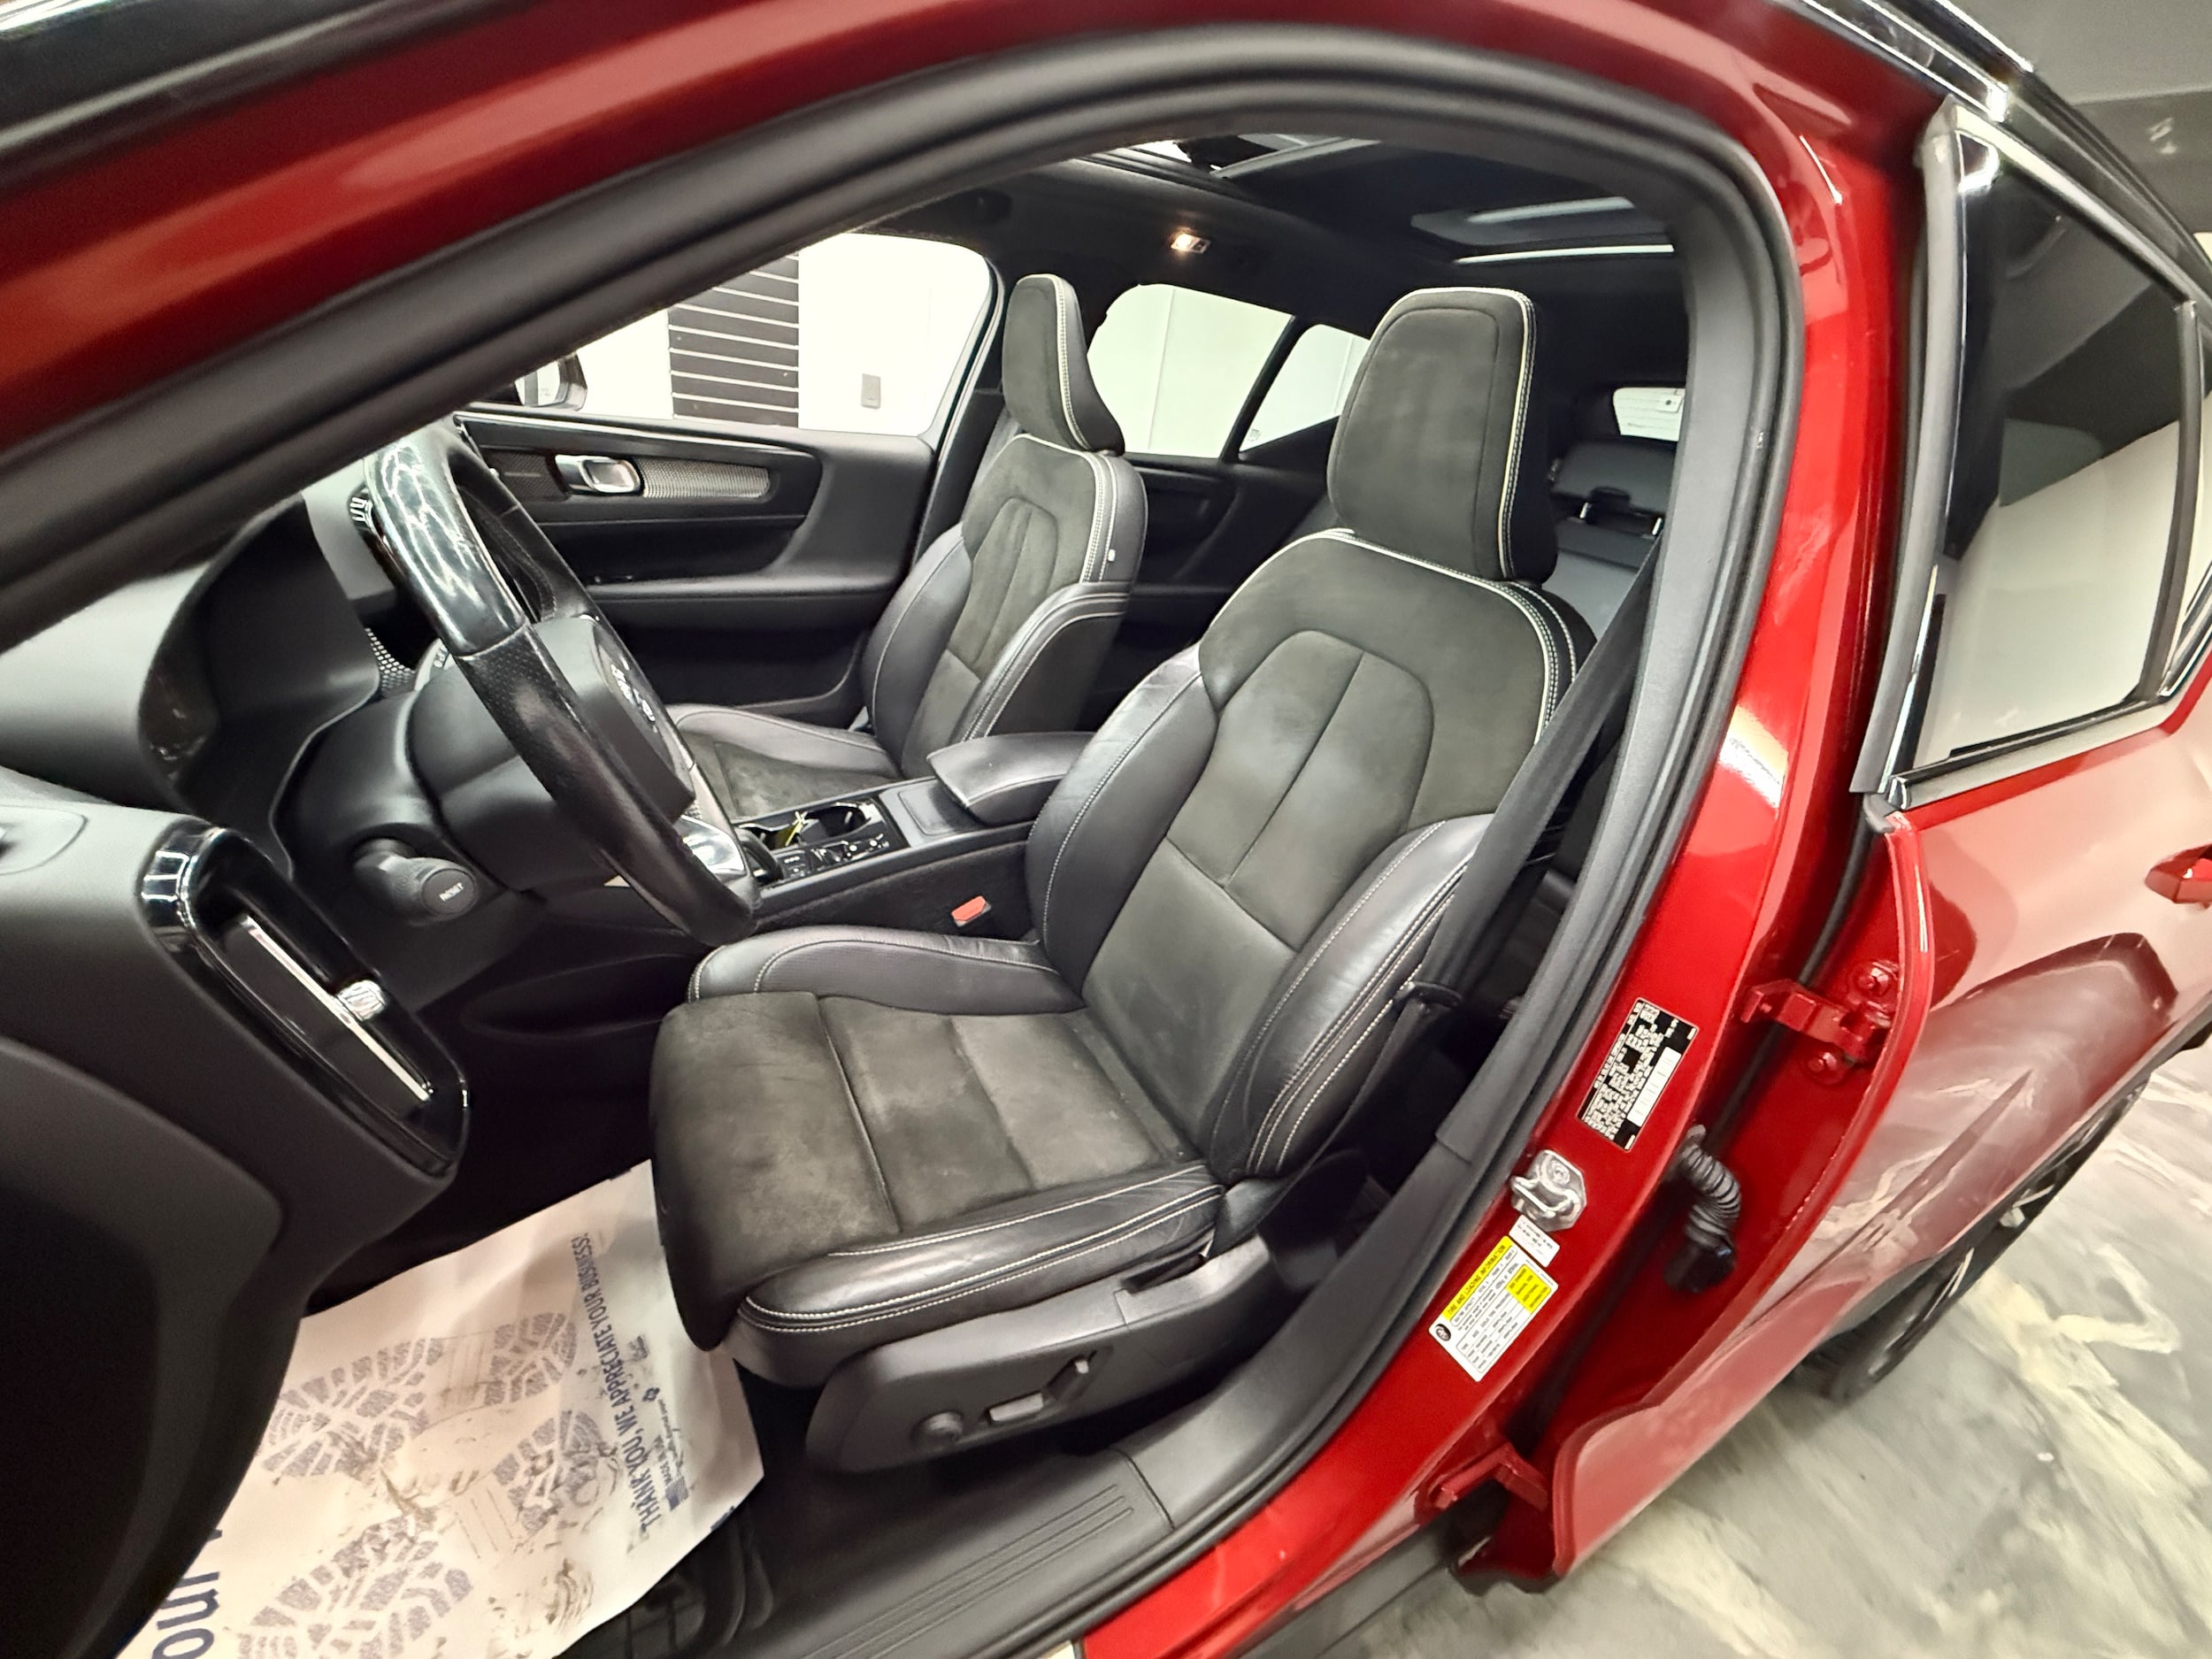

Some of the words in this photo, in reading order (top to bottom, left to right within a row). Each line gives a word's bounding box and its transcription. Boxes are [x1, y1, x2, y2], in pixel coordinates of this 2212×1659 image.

[572, 1233, 599, 1293] BUSINESS!
[584, 1288, 609, 1331] YOUR
[594, 1325, 632, 1408] APPRECIATE
[614, 1405, 637, 1436] WE
[621, 1428, 648, 1476] YOU,
[630, 1468, 662, 1532] THANK
